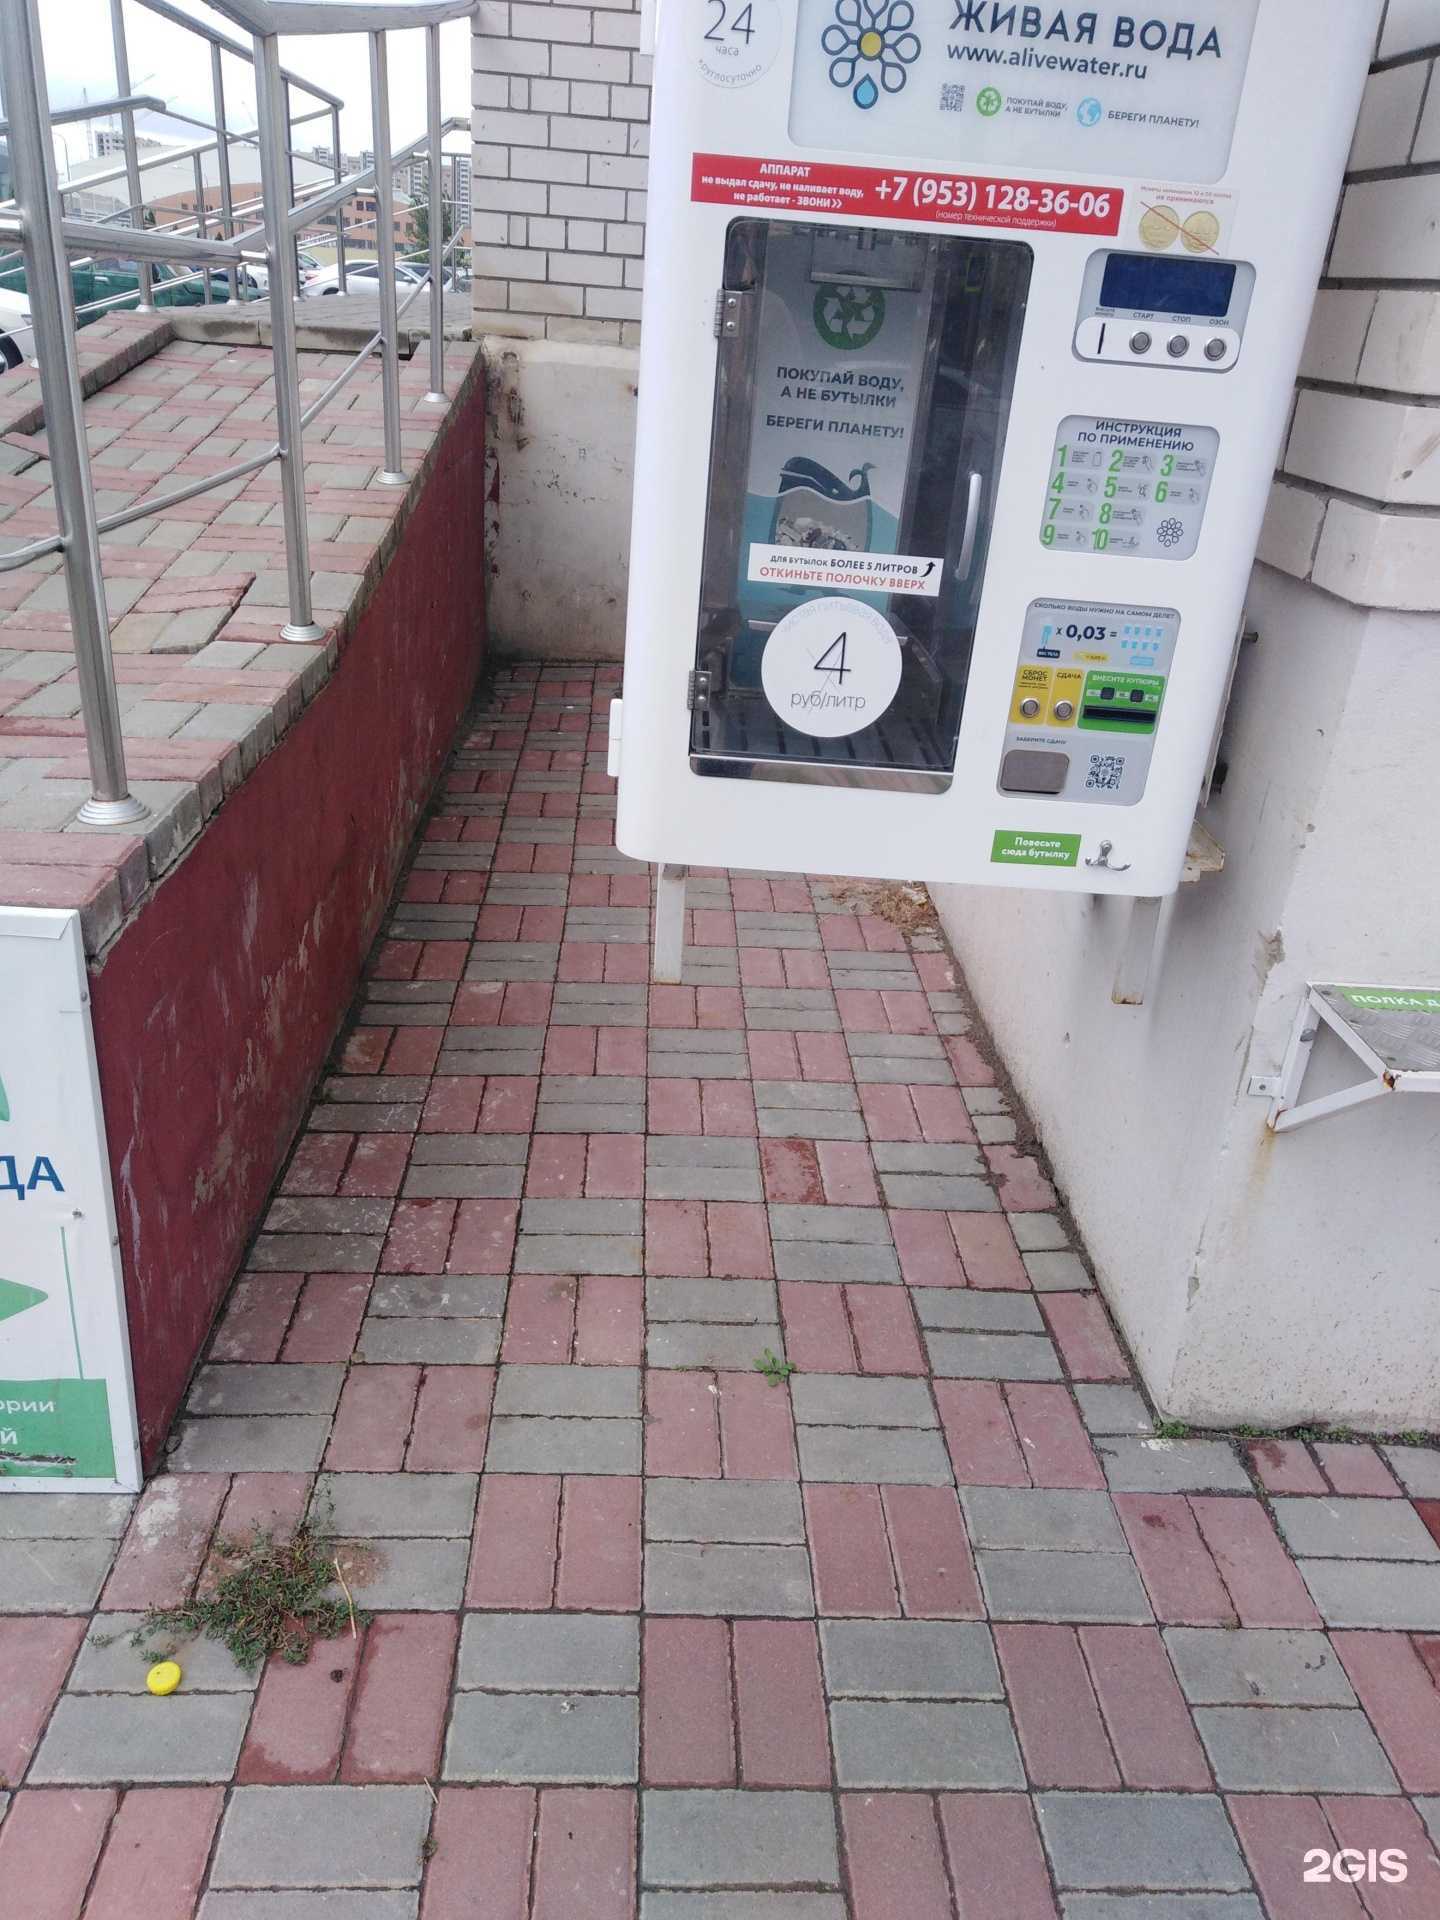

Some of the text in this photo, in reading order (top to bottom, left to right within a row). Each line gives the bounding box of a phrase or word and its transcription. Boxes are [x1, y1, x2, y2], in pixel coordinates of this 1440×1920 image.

[704, 0, 755, 44] 24
[950, 0, 1222, 61] ЖИВАЯ ВОДА
[715, 45, 740, 56] часа
[947, 43, 1147, 80] www.alivewater.ru
[1108, 110, 1200, 128] БЕРЕГИ ПЛАНЕТУ!
[759, 163, 811, 176] АППАРАТ
[701, 176, 864, 198] не выдал сдачу, не наливает воду,
[733, 191, 746, 200] не
[747, 193, 790, 205] работает
[875, 177, 1111, 218] +7 (953) 128-36-06
[964, 213, 1011, 224] технической
[1133, 312, 1155, 321] СТАРТ
[1172, 315, 1192, 323] СТОП
[1209, 319, 1230, 327] ОЗОН
[776, 366, 905, 392] ПОКУПАЙ ВОДУ,
[780, 386, 897, 408] А НЕ БУТЫЛКИ
[766, 415, 905, 439] БЕРЕГИ ПЛАНЕТУ!
[1095, 420, 1182, 438] ИНСТРУКЦИЯ
[1077, 432, 1194, 452] ПО ПРИМЕНЕНИЮ
[1057, 445, 1068, 467] 1
[1108, 449, 1124, 472] 2
[1160, 454, 1174, 476] 3
[1051, 472, 1169, 503] 4 5 6
[1050, 498, 1062, 519] 7
[1100, 502, 1113, 524] 8
[1041, 524, 1108, 550] 9 10
[770, 555, 788, 563] ДЛЯ
[789, 557, 828, 567] БУТЫЛОК
[830, 559, 865, 570] БОЛЕЕ
[874, 564, 918, 574] ЛИТРОВ
[760, 567, 926, 590] ОТКИНЬТЕ ПОЛОЧКУ ВВЕРХ
[1066, 624, 1106, 641] 0,03
[814, 632, 852, 685] 4
[1057, 672, 1081, 680] СДАЧА
[790, 690, 866, 711] руб/литр
[1015, 837, 1061, 848] Повесьте
[1001, 848, 1070, 860] сюда бутылку
[1351, 995, 1425, 1006] ПОЛКА
